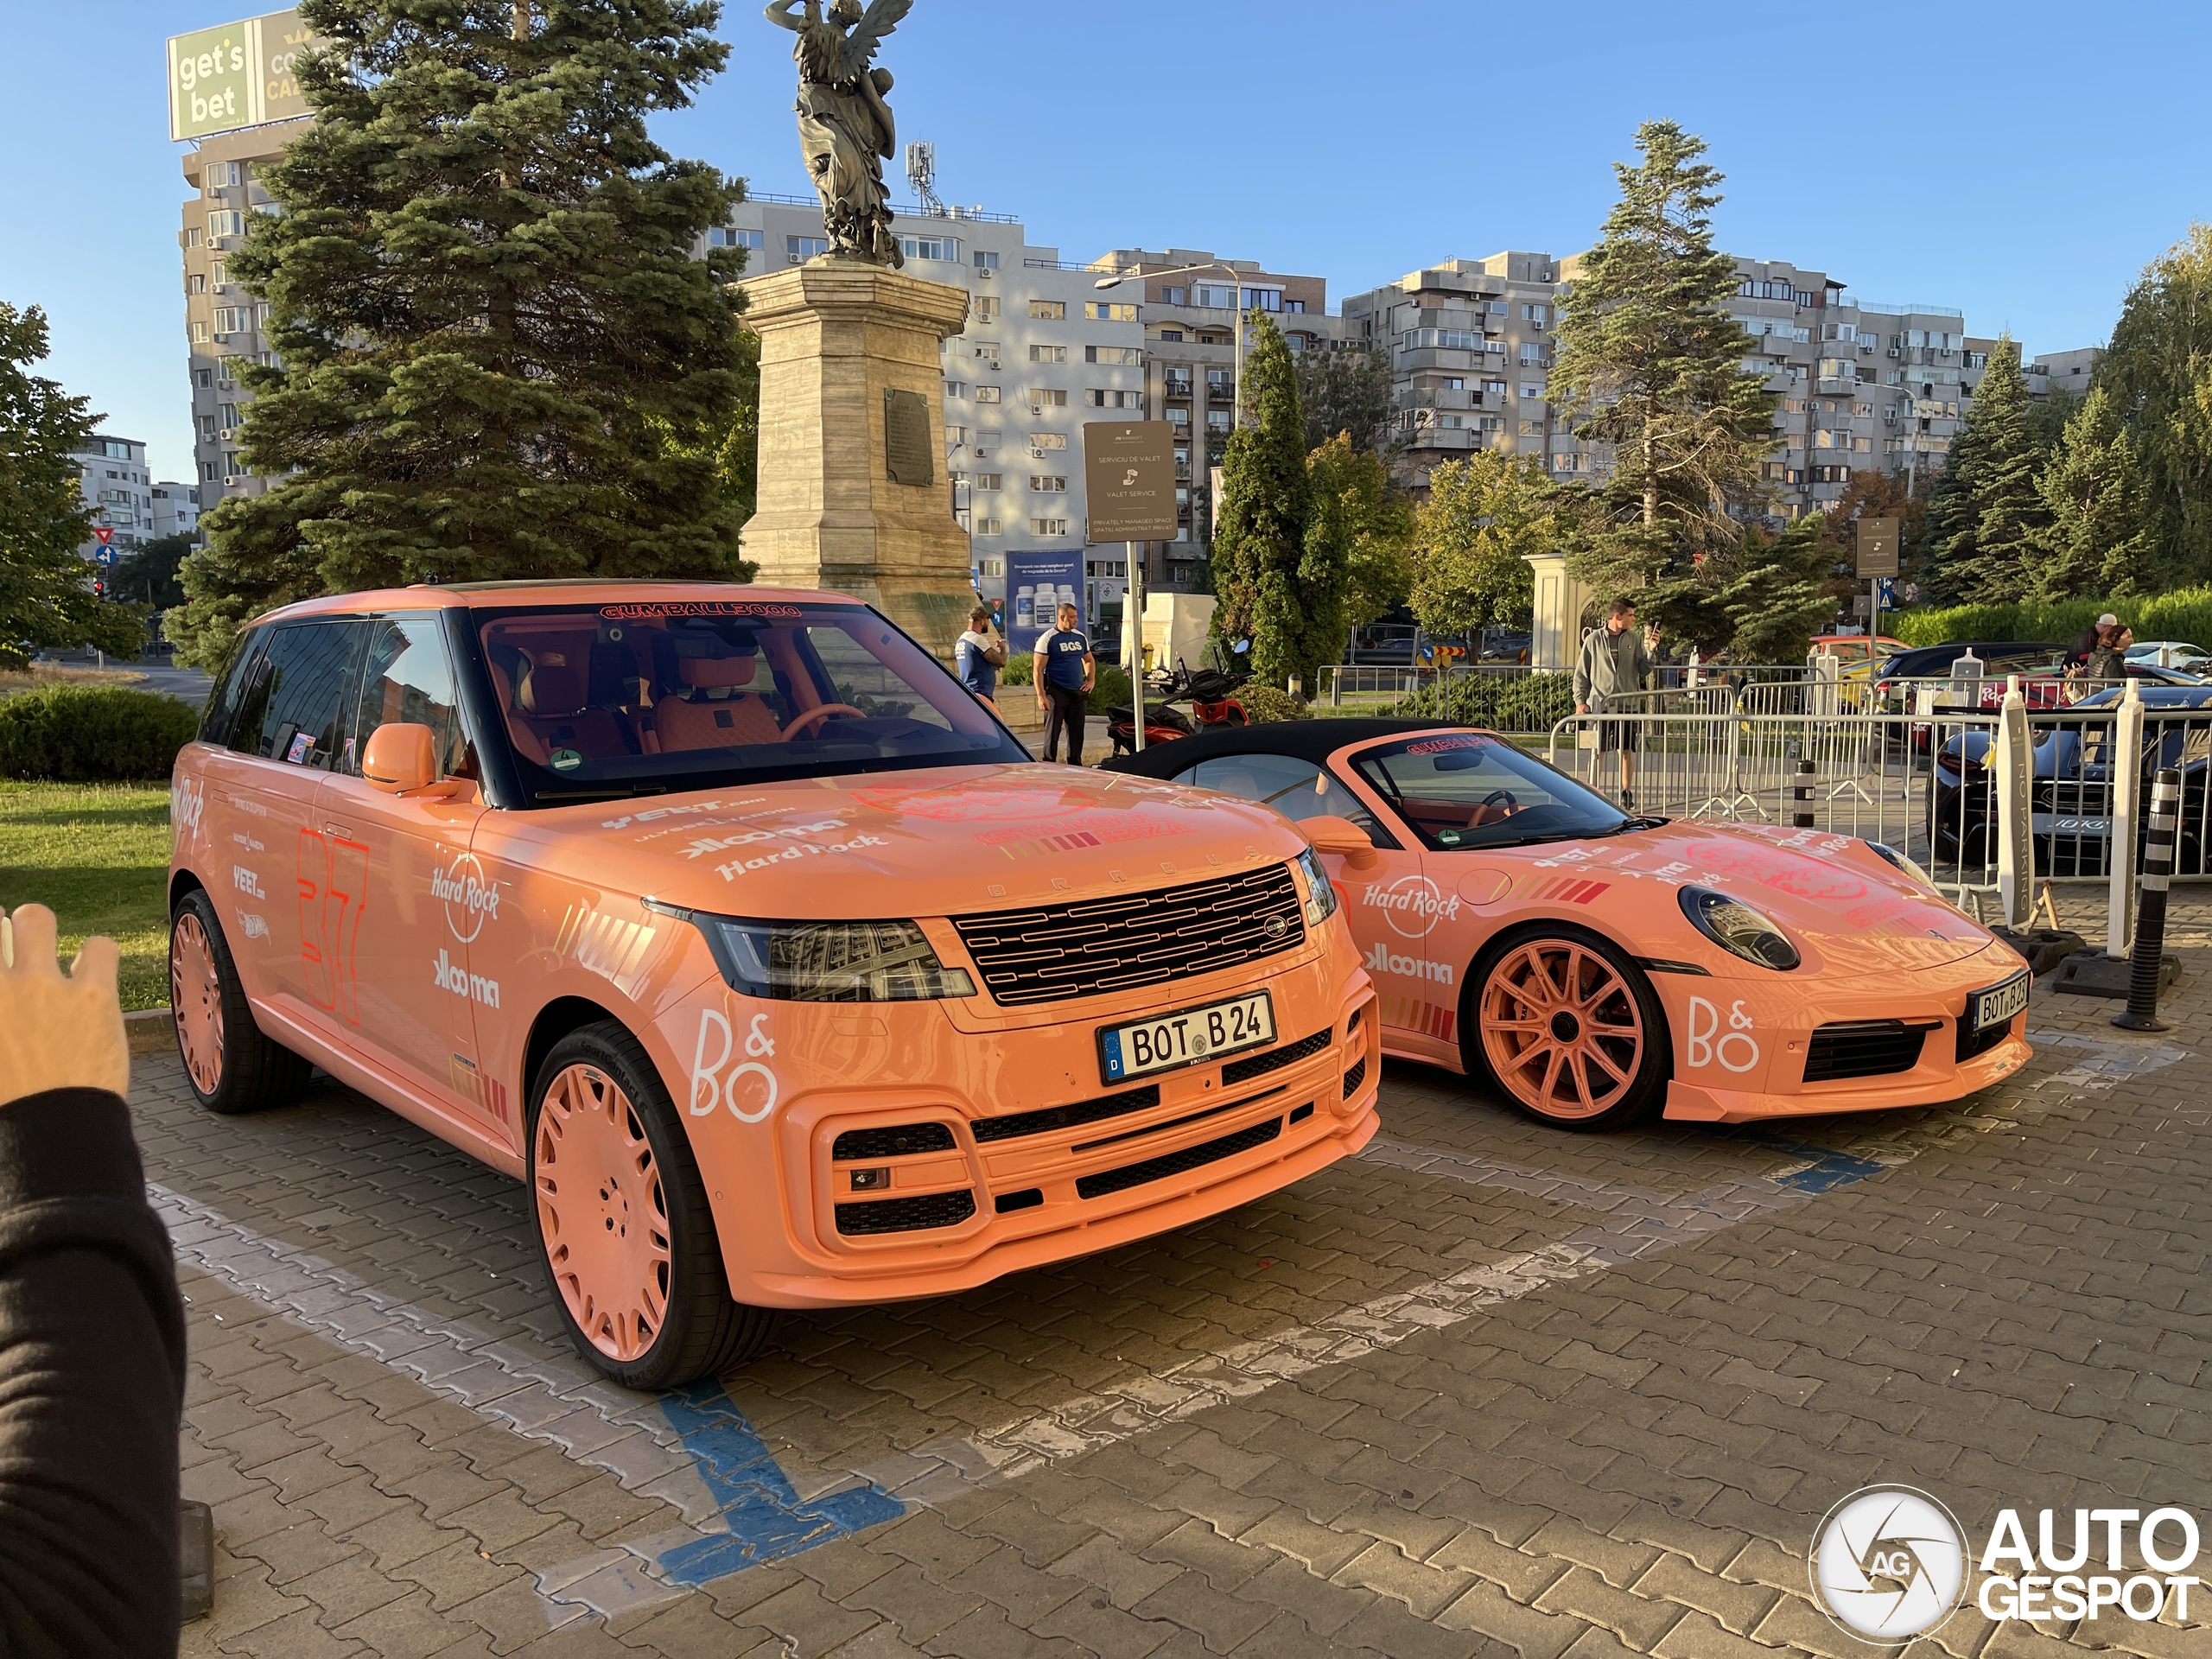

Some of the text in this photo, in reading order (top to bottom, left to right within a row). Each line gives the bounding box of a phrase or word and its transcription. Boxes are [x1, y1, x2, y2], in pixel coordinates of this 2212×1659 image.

[179, 38, 244, 91] get's
[191, 86, 236, 123] bet
[1059, 641, 1083, 652] BGS
[562, 750, 570, 760] 4
[634, 819, 709, 842] ULYSSE
[2018, 763, 2029, 912] NO PARKING
[715, 834, 890, 882] Hard Rock
[431, 868, 499, 921] Hard Rock
[1363, 885, 1460, 921] Hard Rock
[1983, 990, 2005, 1023] BOT
[1132, 1019, 1188, 1067] BOT
[1110, 1059, 1118, 1071] D
